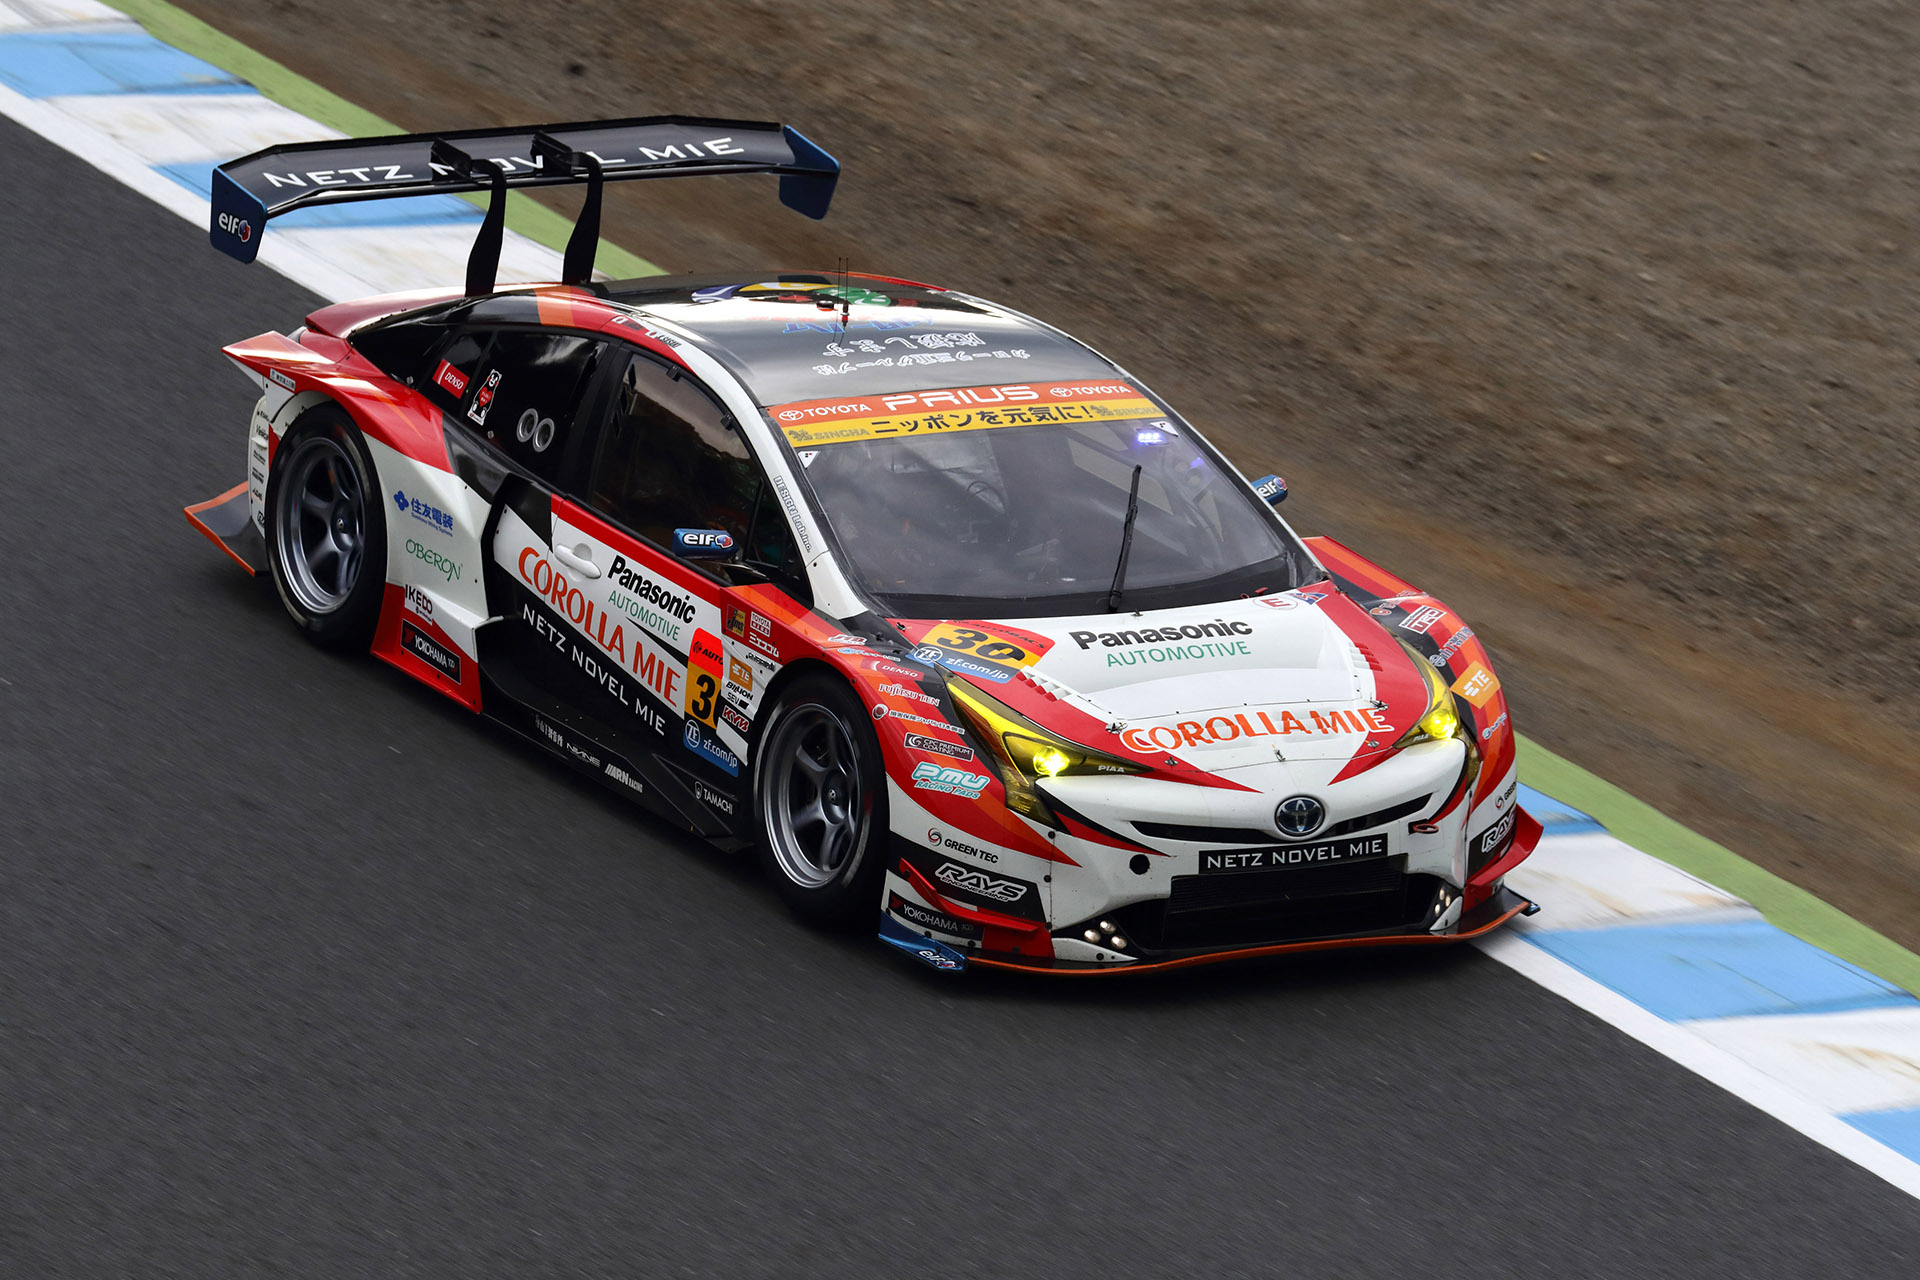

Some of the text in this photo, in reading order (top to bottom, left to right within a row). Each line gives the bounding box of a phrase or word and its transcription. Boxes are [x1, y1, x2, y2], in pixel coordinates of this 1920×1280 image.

[263, 165, 414, 188] NETZ
[639, 137, 745, 160] MIE
[218, 211, 239, 235] elf
[444, 372, 464, 390] DENSO
[1071, 385, 1132, 395] TOYOTA
[804, 403, 872, 417] TOYOTA
[882, 385, 1040, 411] PRIUS
[812, 428, 871, 440] SINGHA
[1257, 481, 1277, 498] elf
[411, 497, 454, 531] 住友電装
[683, 533, 715, 545] elf
[406, 539, 461, 582] OBERON
[607, 555, 696, 624] Panasonic
[518, 546, 681, 708] COROLLA MIE
[608, 590, 681, 641] AUTOMOTIVE
[752, 613, 770, 628] TOYOTA
[937, 628, 1025, 661] 30
[1068, 619, 1253, 650] Panasonic
[415, 635, 448, 668] YOKOHAMA
[1106, 641, 1251, 667] AUTOMOTIVE
[523, 603, 666, 736] NETZ NOVEL MIE
[882, 665, 918, 678] DENSO
[945, 656, 1009, 680] zf.com/jp
[1471, 669, 1490, 687] TE
[726, 681, 753, 700] BILLION
[727, 692, 739, 705] SEV
[878, 683, 940, 707] FUJITSU TEN
[1121, 707, 1395, 753] COROLLA MIE
[703, 739, 738, 769] zf.com/jp
[923, 738, 970, 755] CPC PREMIUM
[923, 743, 954, 755] COATING
[1098, 765, 1125, 773] PIAA
[703, 788, 733, 815] TAMACHI
[914, 780, 981, 799] RACING PADS
[944, 838, 999, 864] GREEN TEC
[1207, 839, 1382, 869] NETZ NOVEL MIE
[935, 863, 1027, 901] RAYS
[941, 876, 1009, 902] ENGINEERING
[903, 904, 958, 931] YOKOHAMA
